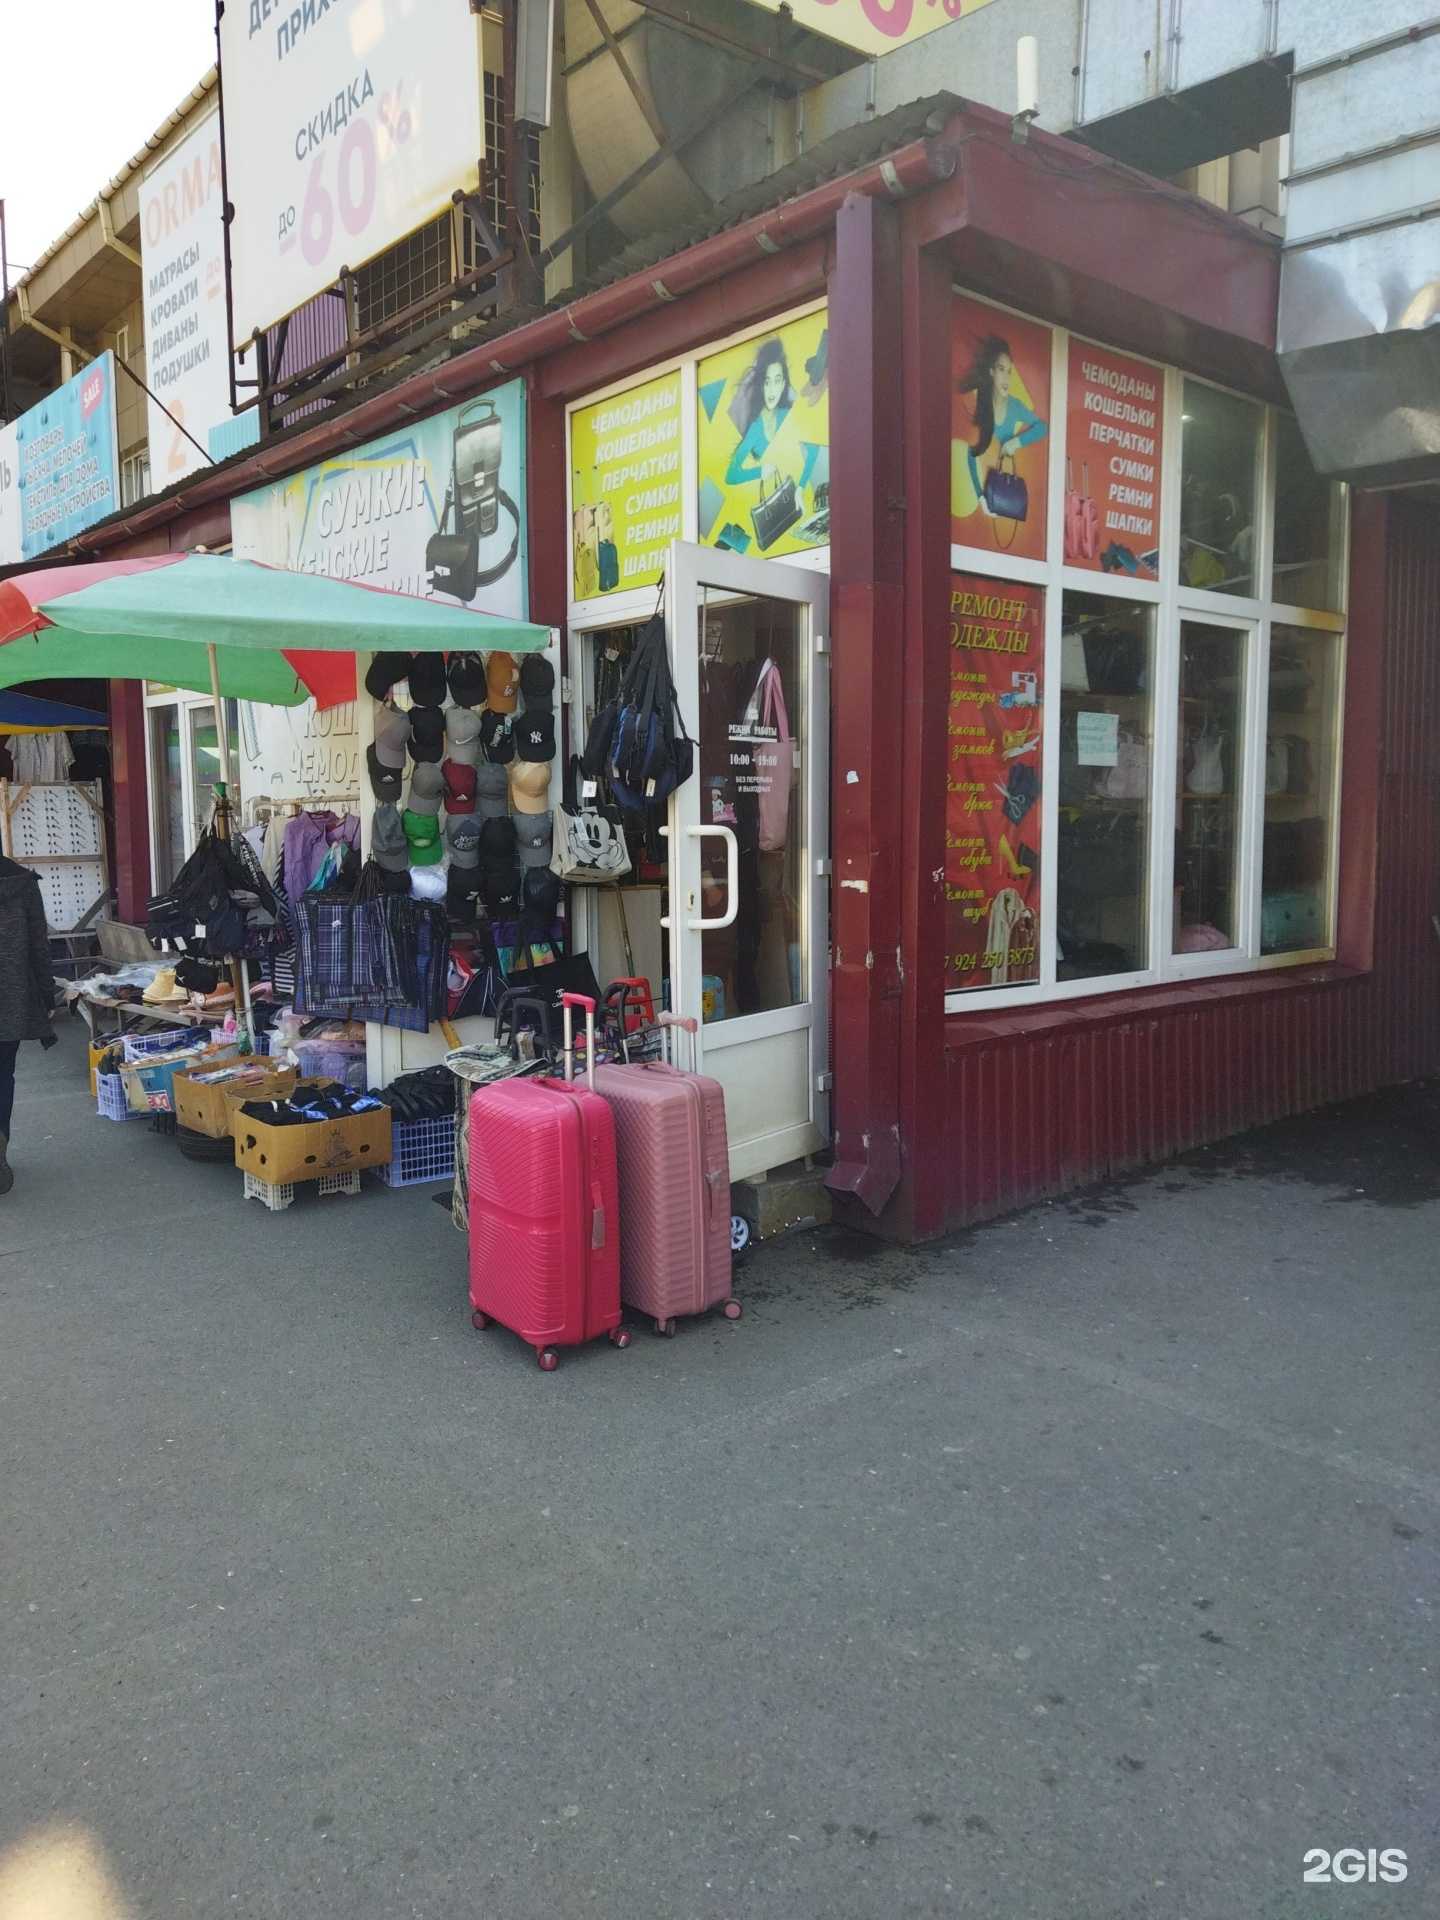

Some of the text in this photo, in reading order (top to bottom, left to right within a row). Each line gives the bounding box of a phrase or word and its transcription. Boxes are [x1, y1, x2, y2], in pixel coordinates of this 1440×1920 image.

[276, 0, 338, 61] ПРИХ
[295, 68, 374, 161] СКИДКА
[278, 205, 296, 240] ДО
[150, 241, 200, 298] МАТРАСЫ
[150, 278, 199, 329] КРОВАТИ
[151, 312, 199, 363] ДИВАНЫ
[153, 337, 210, 391] ПОДУШКИ
[1082, 361, 1156, 400] ЧЕМОДАНЫ
[83, 377, 101, 409] SALE
[591, 383, 678, 435] ЧЕМОДАНЫ
[1084, 391, 1156, 429] КОШЕЛЬКИ
[595, 417, 678, 465] КОШЕЛЬКИ
[1089, 421, 1155, 456] ПЕРЧАТКИ
[601, 452, 679, 493] ПЕРЧАТКИ
[1110, 456, 1154, 483] СУМКИ
[624, 483, 679, 517] СУМКИ
[1109, 483, 1153, 510] РЕМНИ
[625, 514, 679, 546] РЕМНИ
[1105, 510, 1153, 537] ШАПКИ
[951, 591, 1027, 622] РЕМОНТ
[730, 753, 750, 766] 10:00
[954, 952, 977, 971] 924
